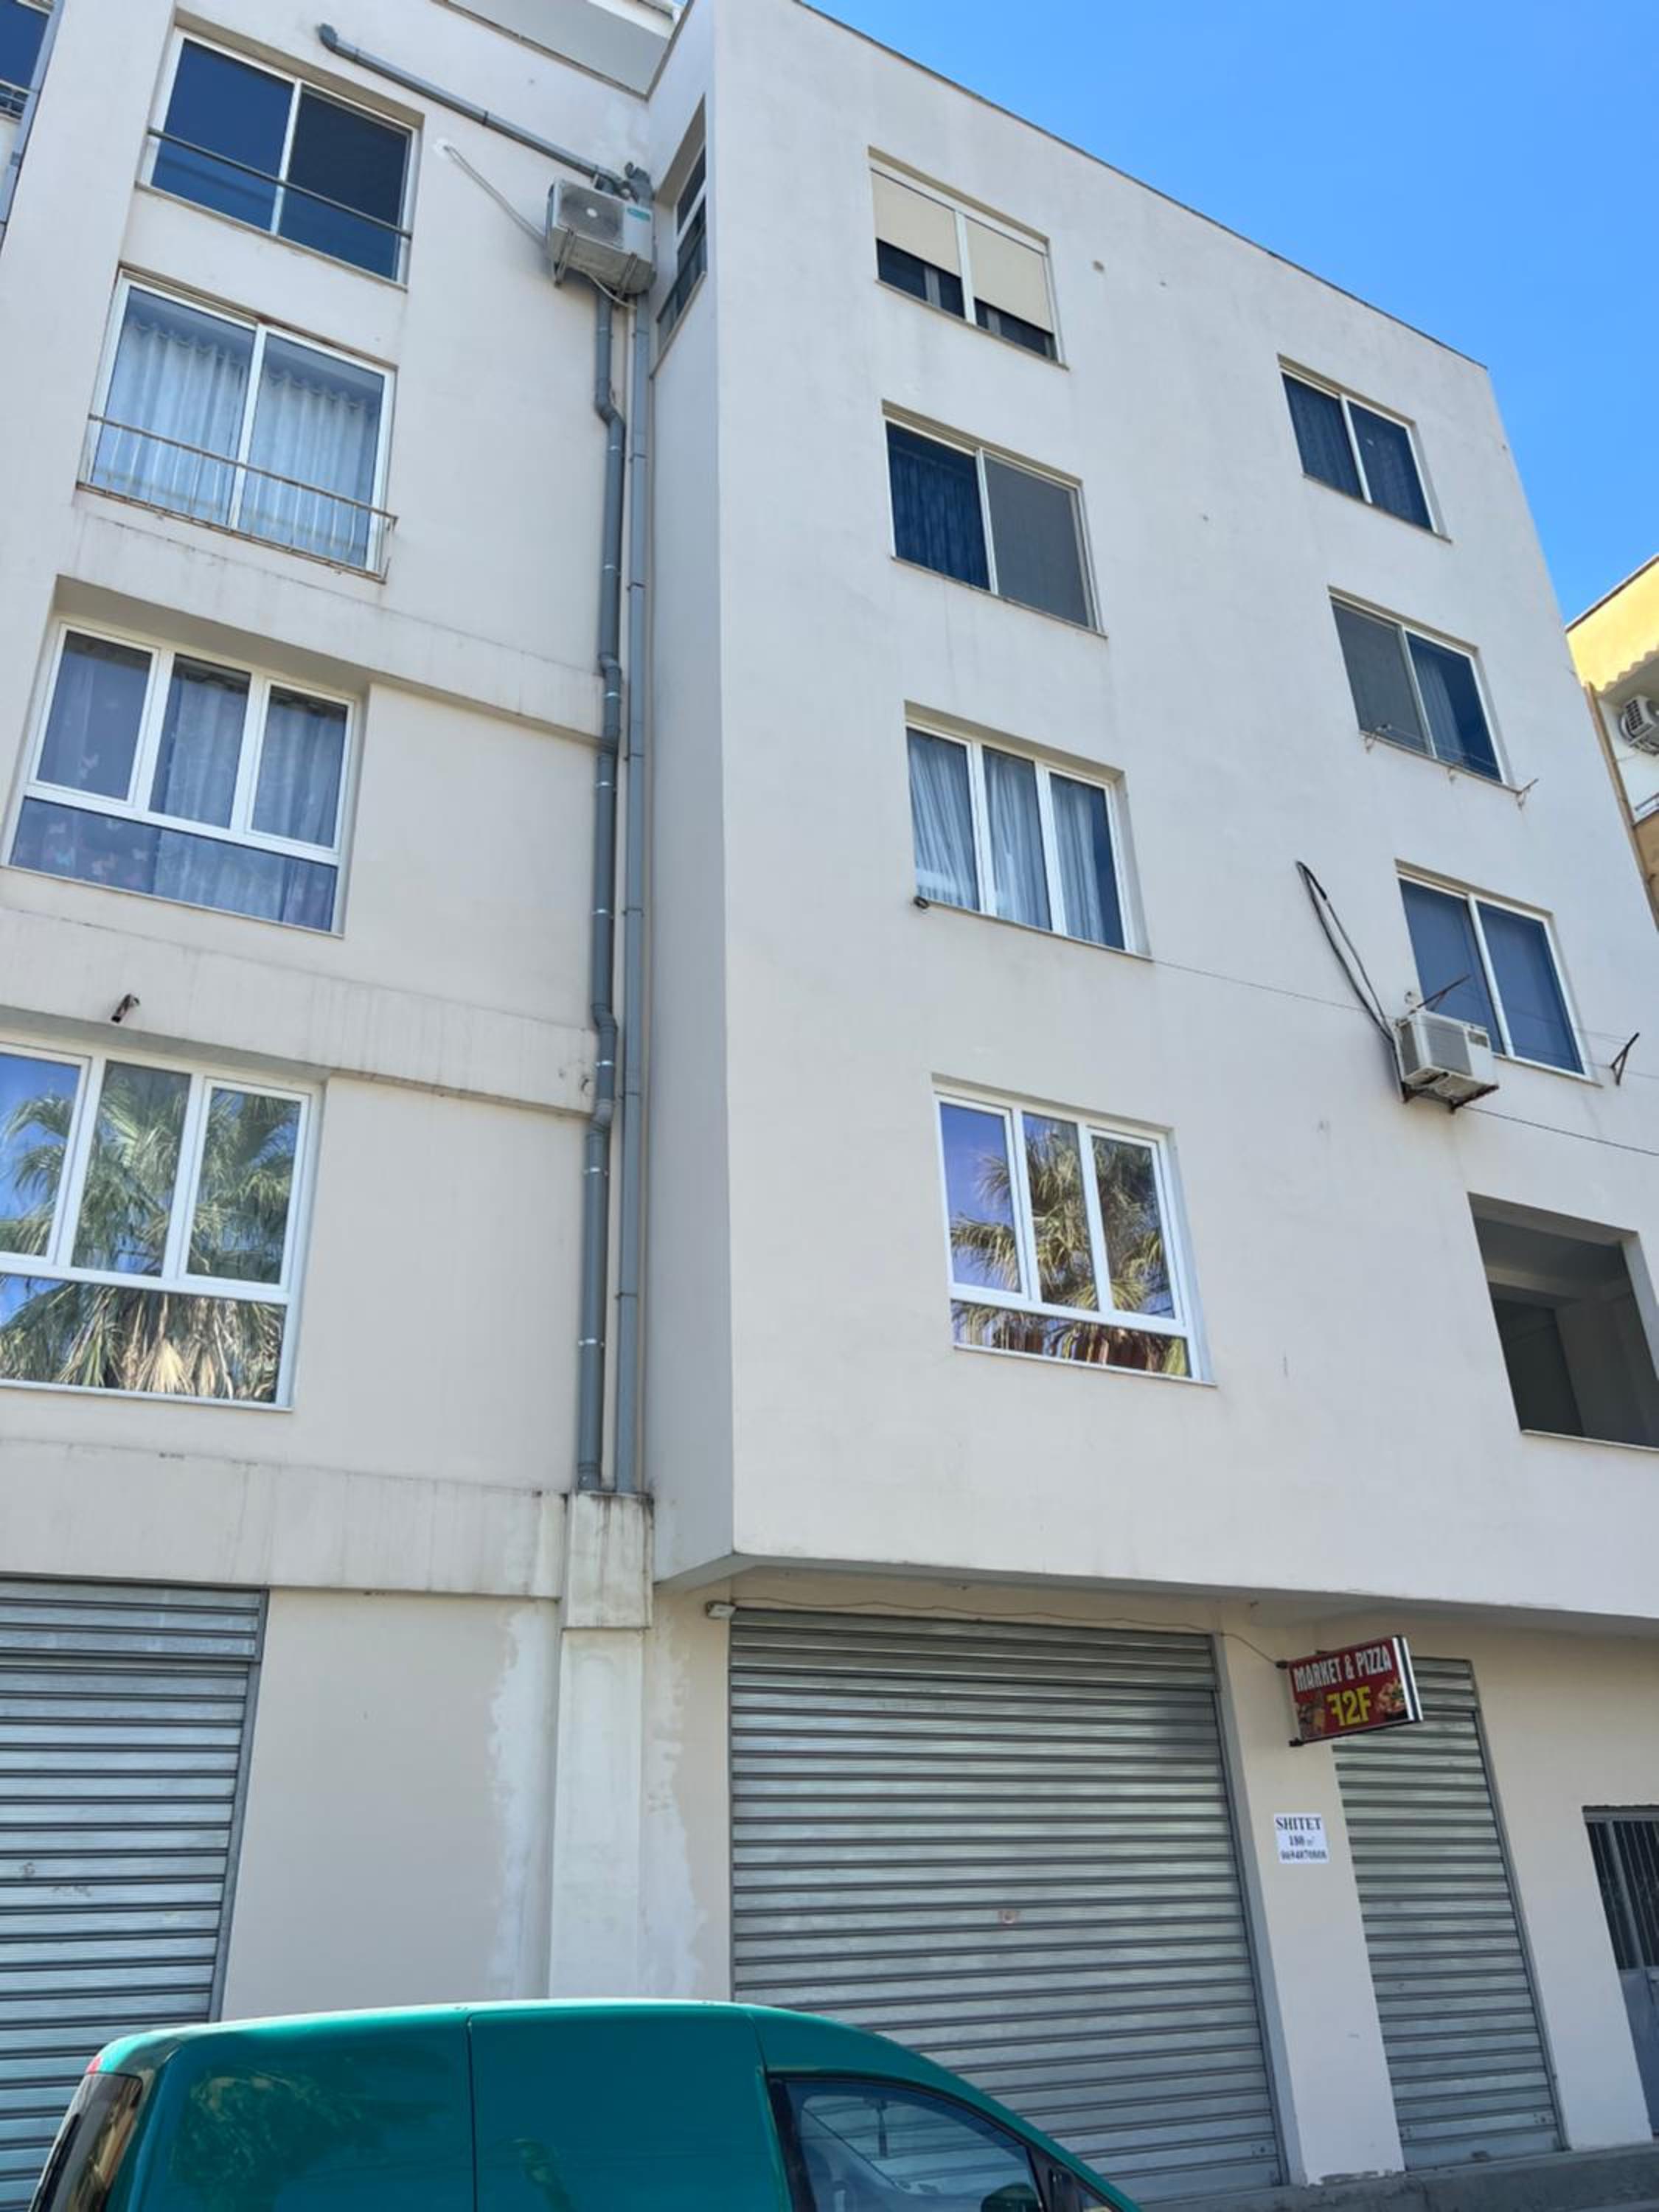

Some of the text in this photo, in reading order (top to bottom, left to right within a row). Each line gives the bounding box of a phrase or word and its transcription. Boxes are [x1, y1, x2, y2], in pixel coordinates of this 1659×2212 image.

[1294, 1645, 1392, 1692] MARKET & PIZZA
[1275, 1816, 1321, 1831] SHITET
